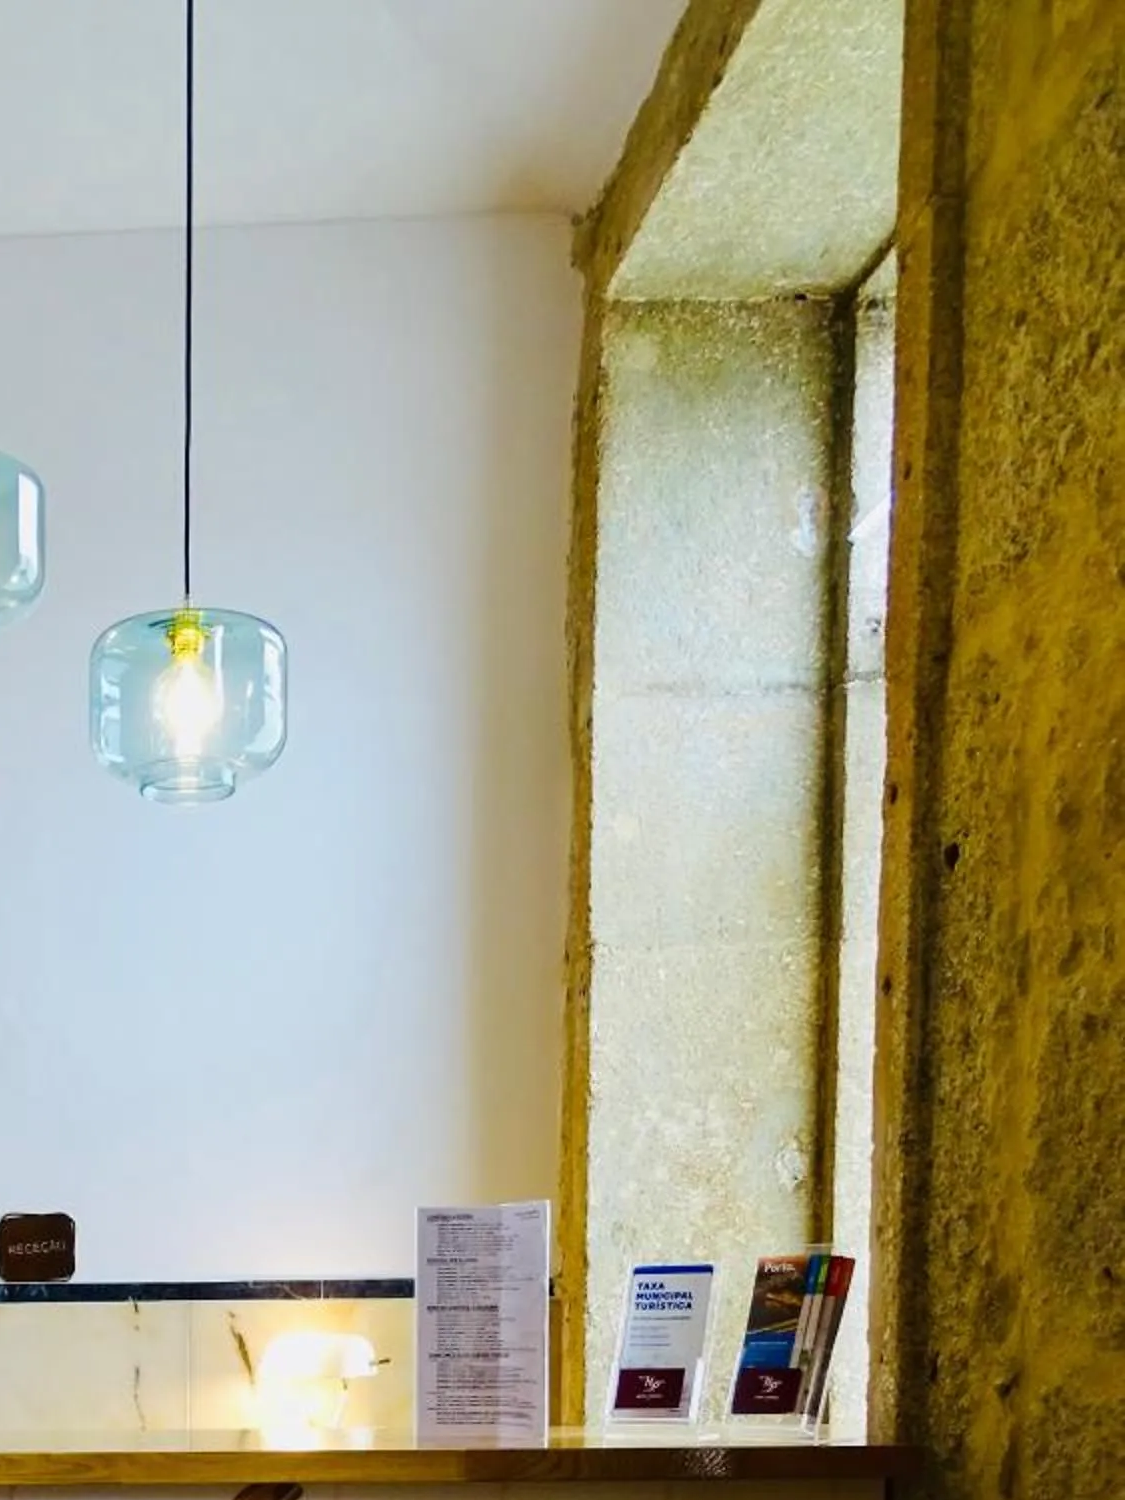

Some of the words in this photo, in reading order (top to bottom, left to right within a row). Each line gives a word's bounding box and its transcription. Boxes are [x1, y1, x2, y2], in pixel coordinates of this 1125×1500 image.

[637, 1282, 665, 1291] TAXA
[636, 1291, 693, 1301] MUNICIPAL
[635, 1301, 692, 1311] TURÍSTICA
